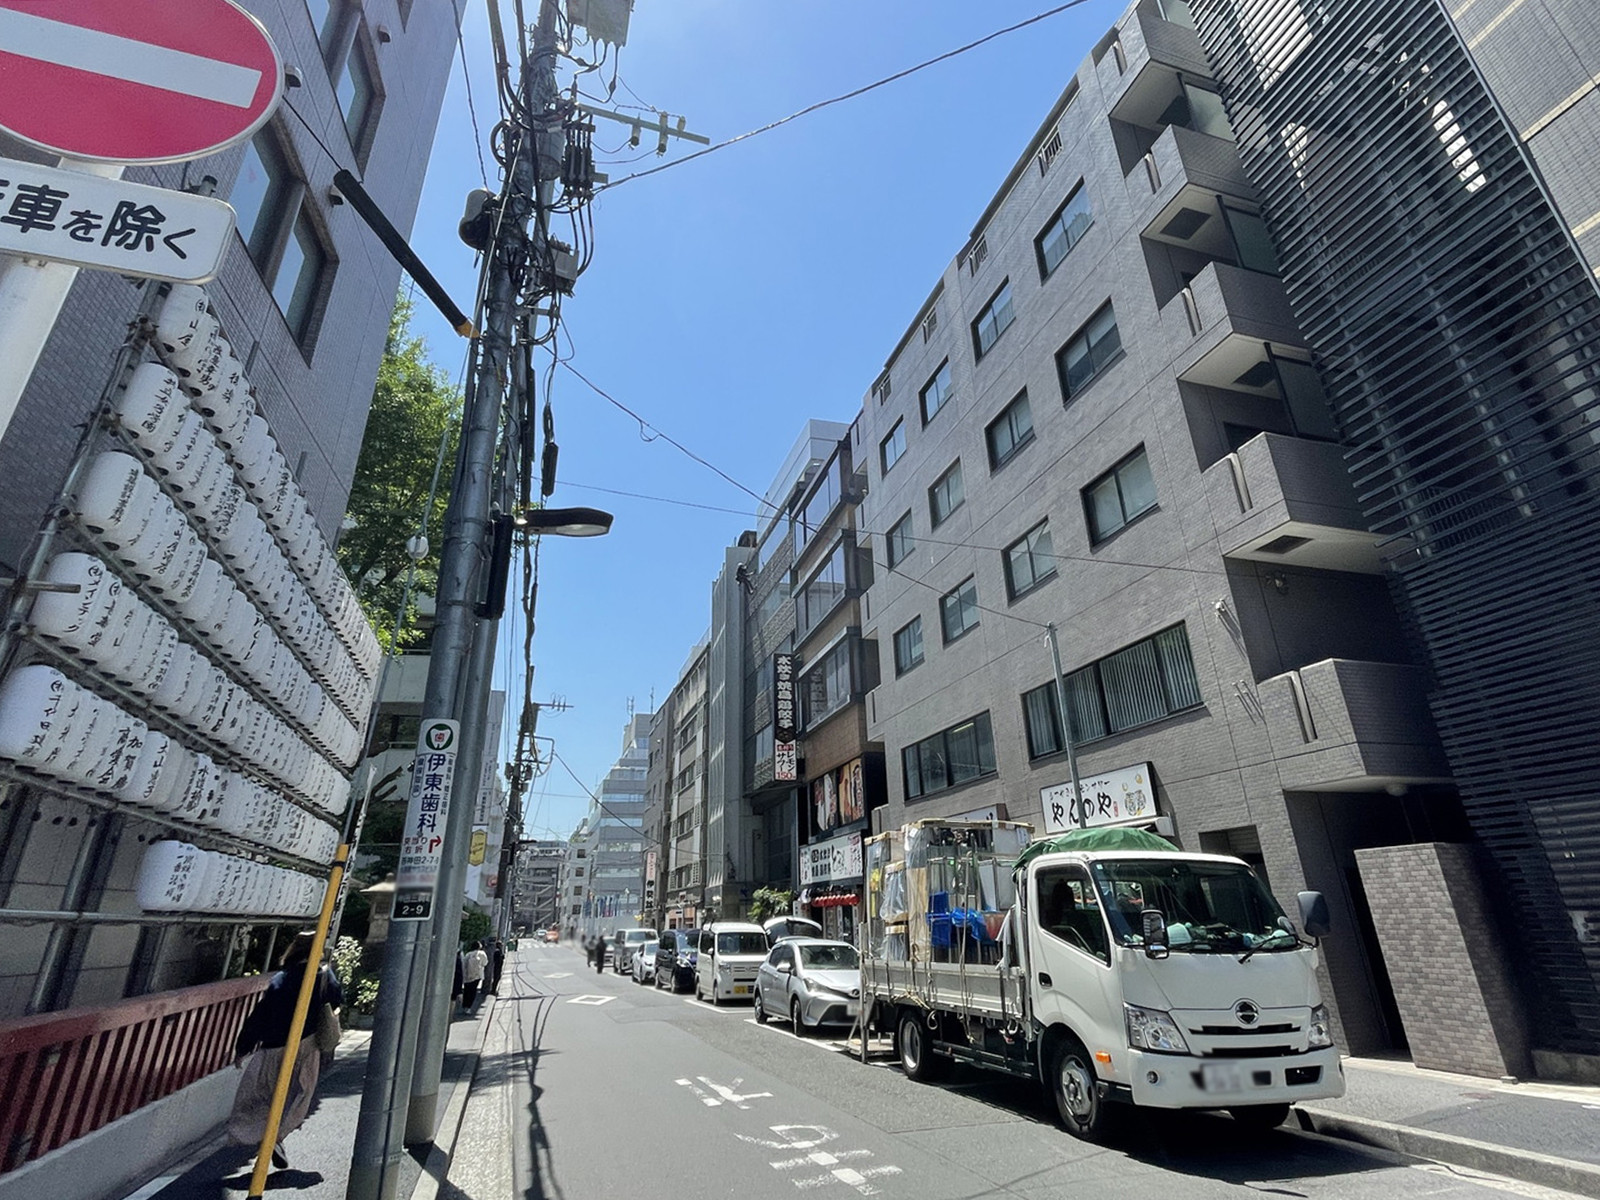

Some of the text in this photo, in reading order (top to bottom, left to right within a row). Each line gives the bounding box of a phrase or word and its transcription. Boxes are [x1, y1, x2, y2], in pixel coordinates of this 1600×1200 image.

[0, 179, 197, 261] 車を除く
[417, 753, 447, 833] 伊東歯科
[1051, 792, 1112, 827] やんのや
[402, 905, 424, 915] 2-9
